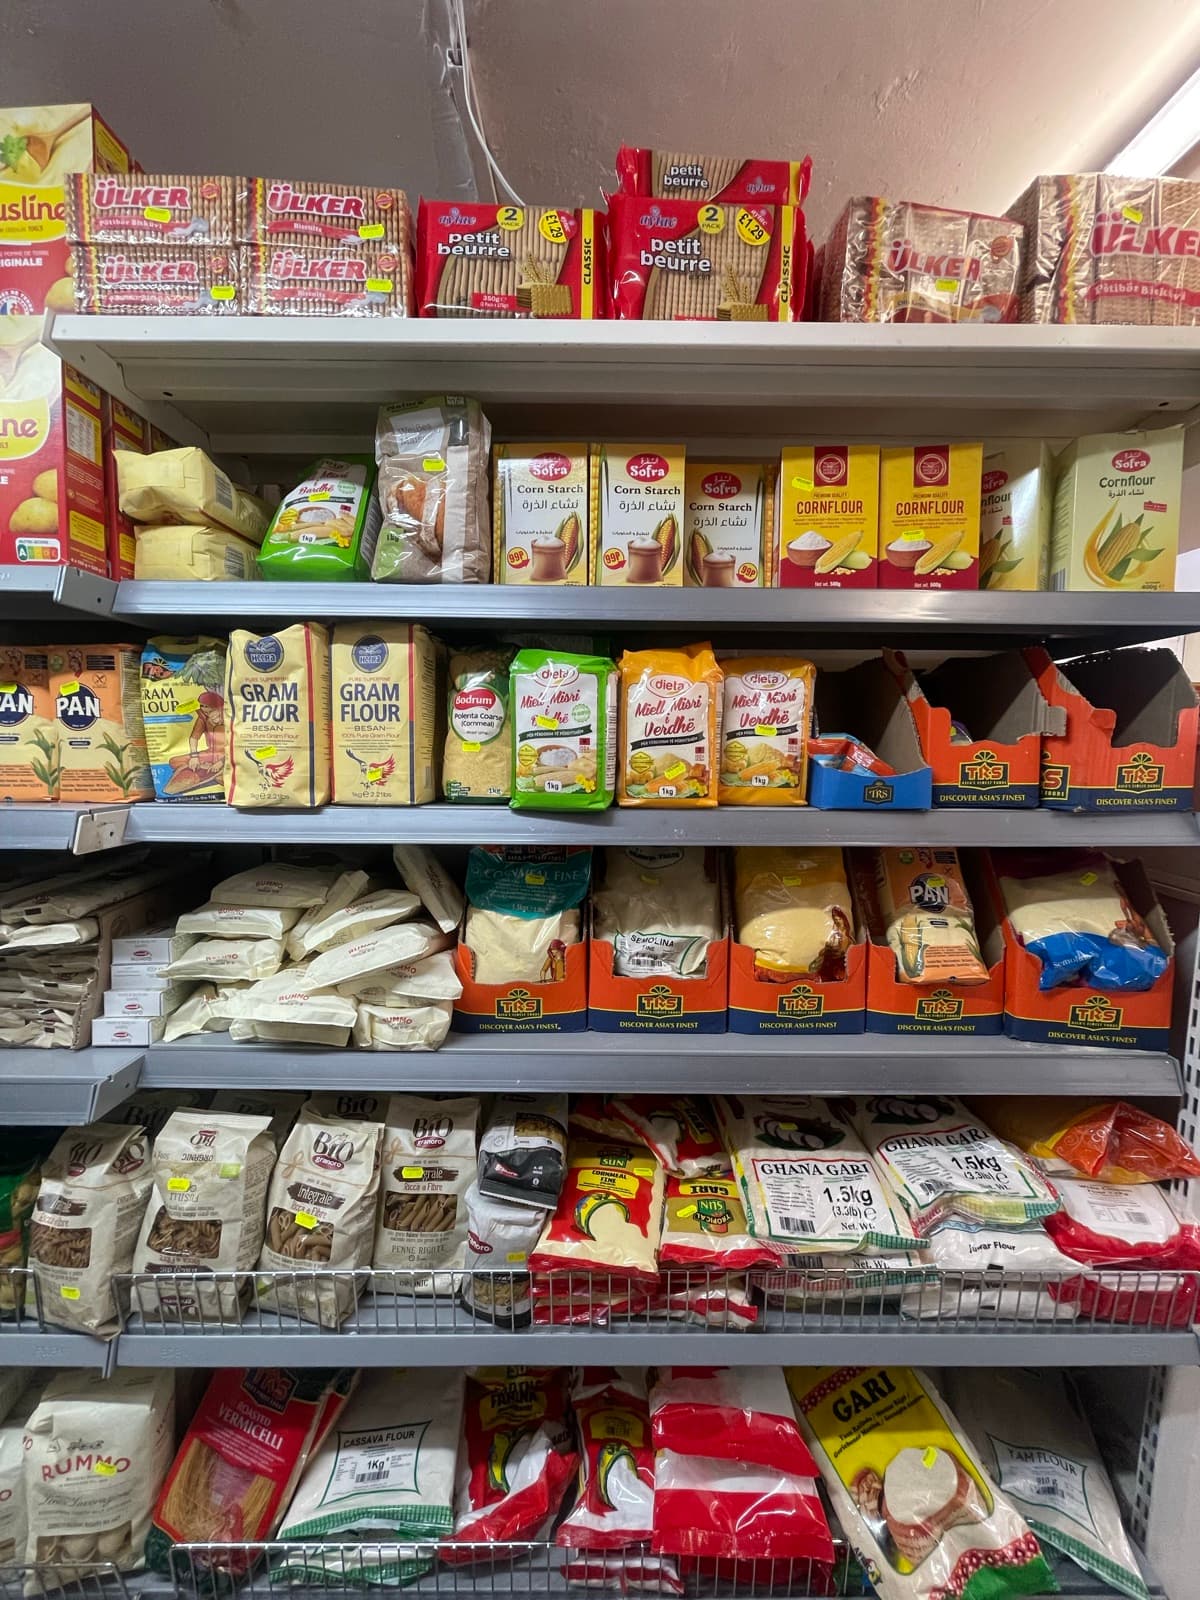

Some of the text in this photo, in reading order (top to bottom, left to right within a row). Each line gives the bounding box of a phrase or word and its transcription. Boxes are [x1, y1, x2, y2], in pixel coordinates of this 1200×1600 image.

[671, 165, 703, 176] petit
[664, 175, 709, 189] beurre
[95, 179, 190, 209] ÜLKER
[267, 184, 365, 219] ÜLKER
[504, 208, 518, 221] 2
[705, 207, 719, 222] 2
[545, 213, 563, 239] £1.29
[738, 213, 764, 240] £1.29
[448, 232, 500, 245] petit
[437, 243, 510, 257] beurre
[651, 238, 701, 255] petit
[271, 250, 366, 281] ÜLKER
[583, 238, 592, 285] CLASSIC
[640, 251, 711, 272] beurre
[104, 256, 199, 283] ÜLKER
[782, 245, 790, 303] CLASSIC
[532, 466, 568, 477] Sofra
[630, 466, 665, 477] Sofra
[1115, 459, 1146, 470] Sofra
[1099, 475, 1155, 488] Cornflour
[517, 485, 584, 494] Corn Starch
[614, 485, 681, 496] Corn Starch
[705, 483, 737, 495] Sofra
[619, 499, 676, 513] نشاء الذرة
[689, 503, 752, 512] Corn Starch
[797, 500, 863, 515] CORNFLOUR
[896, 500, 964, 516] CORNFLOUR
[694, 516, 747, 528] نشاء الذرة
[508, 551, 524, 563] 99P
[605, 552, 620, 564] 99P
[741, 565, 755, 577] 99P
[750, 673, 779, 684] dieta
[240, 683, 298, 702] GRAM
[340, 683, 400, 702] GRAM
[655, 681, 684, 692] dieta
[455, 695, 493, 706] Bodrum
[550, 689, 581, 706] Misri
[242, 704, 299, 722] FLOUR
[341, 704, 401, 722] FLOUR
[635, 695, 702, 718] Miell Misri
[455, 713, 503, 721] Polenta Coarse
[461, 720, 495, 728] (Cornmeal)
[740, 708, 789, 727] Verdhë
[644, 717, 695, 737] Verdhë
[966, 763, 1003, 780] TRS
[1123, 766, 1159, 784] TRS
[547, 782, 559, 791] 1kg
[754, 776, 766, 785] 1kg
[662, 788, 674, 796] 1kg
[869, 790, 888, 799] TRS
[630, 934, 674, 948] SEMOLINA
[279, 993, 310, 1001] RUMMO
[642, 996, 677, 1010] TRS
[783, 996, 817, 1011] TRS
[501, 1001, 536, 1012] TRS
[922, 1000, 958, 1013] TRS
[1076, 1006, 1115, 1022] TRS
[1048, 1031, 1137, 1043] DISCOVER ASIA'S FINEST
[885, 1128, 990, 1153] GHANA GARI
[314, 1155, 342, 1169] granoro
[602, 1158, 624, 1167] SUN
[951, 1155, 1002, 1171] 1.5kg
[592, 1169, 627, 1180] CORNMEAL
[761, 1163, 869, 1177] GHANA GARI
[963, 1171, 995, 1181] (3.3lb)
[427, 1182, 443, 1191] Fibre
[691, 1184, 729, 1196] GARI
[298, 1185, 333, 1205] Integrale
[823, 1185, 873, 1207] 1.5kg
[699, 1199, 723, 1211] SUN
[695, 1212, 735, 1226] TROPICAL
[832, 1206, 862, 1219] (3.3lb)
[860, 1223, 875, 1231] Wt.
[392, 1245, 415, 1255] PENNE
[994, 1241, 1015, 1251] Flour
[832, 1369, 897, 1422] GARI
[236, 1400, 271, 1427] ROASTED
[218, 1401, 284, 1451] VERMICELLI
[343, 1430, 415, 1449] CASSAVA FLOUR
[367, 1460, 384, 1471] 1Kg
[1008, 1447, 1078, 1476] YAM FLOUR
